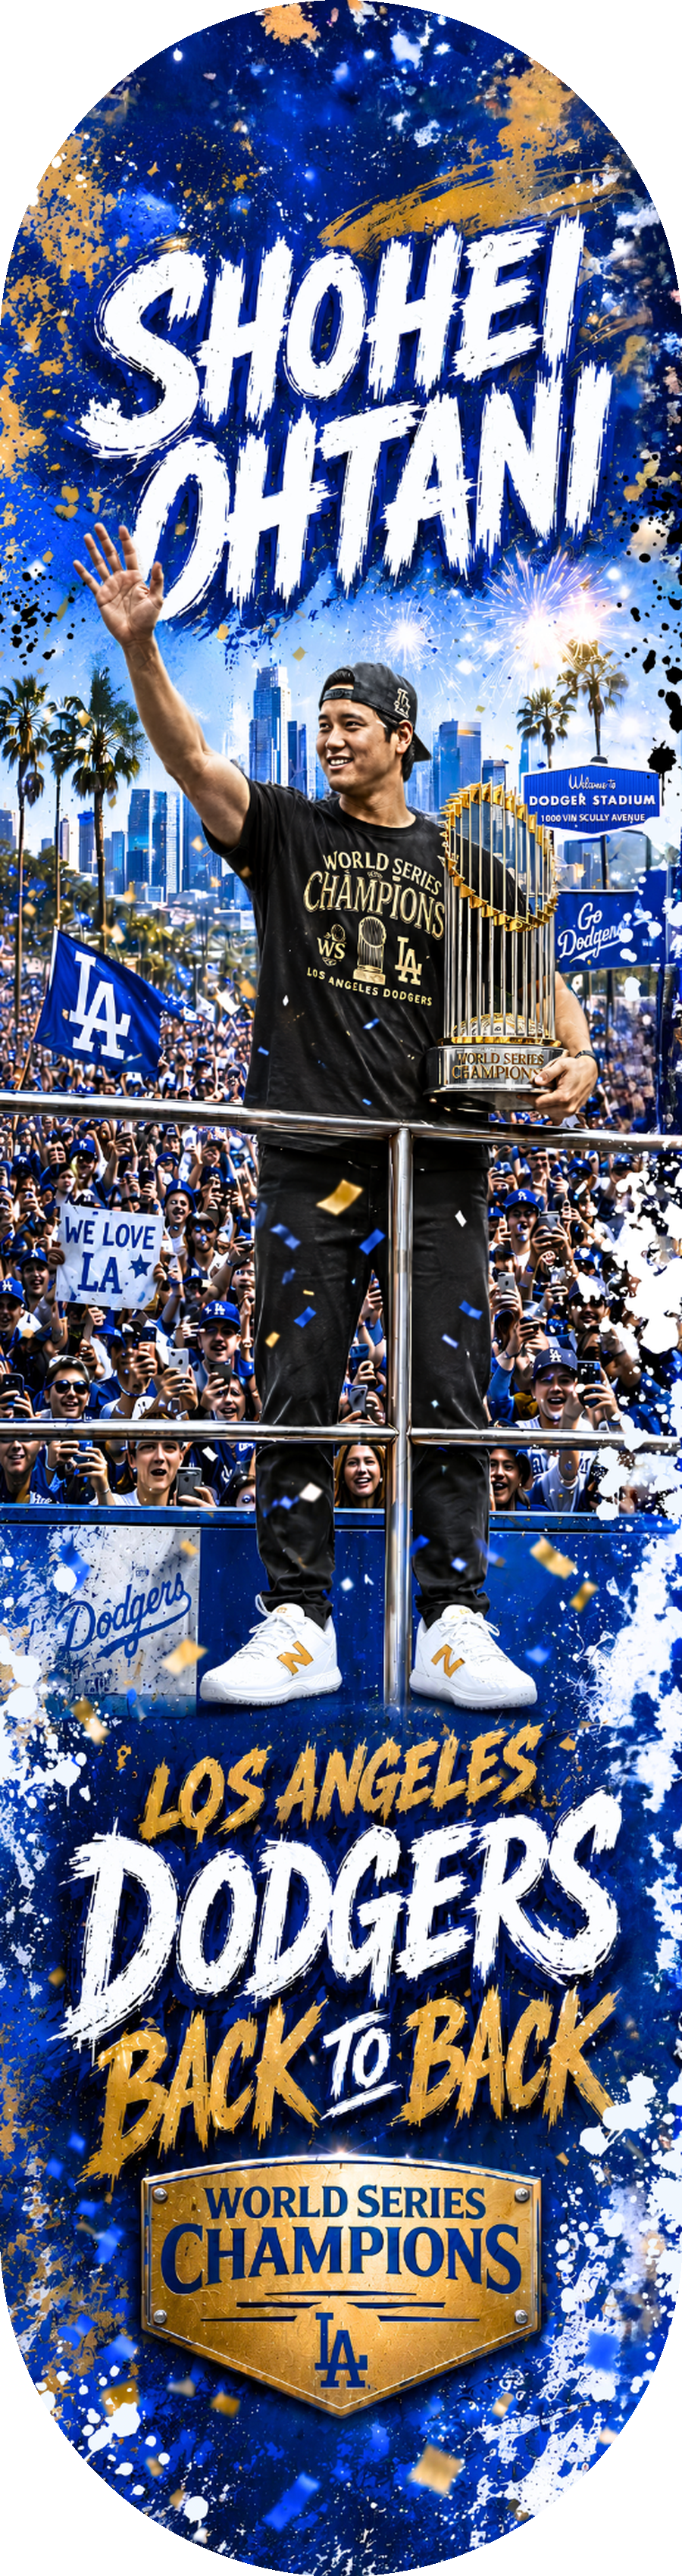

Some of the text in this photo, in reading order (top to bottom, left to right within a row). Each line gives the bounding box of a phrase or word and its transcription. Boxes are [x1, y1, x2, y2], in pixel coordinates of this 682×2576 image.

[529, 795, 655, 806] DODGER STADIUM
[607, 779, 616, 789] to
[579, 814, 609, 822] SCULLY
[611, 814, 646, 822] AVENUE
[323, 850, 443, 896] WORLD SERIES
[304, 871, 445, 940] CHAMPIONS
[577, 902, 603, 930] Go
[317, 937, 346, 960] WS
[395, 936, 422, 985] LA
[307, 967, 433, 1006] LOS ANGELES DODGERS
[69, 950, 131, 1060] LA
[457, 1052, 544, 1064] WORLD SERIES
[65, 1216, 156, 1250] WE LOVE
[77, 1252, 123, 1294] LA
[55, 1572, 192, 1659] Dodgers
